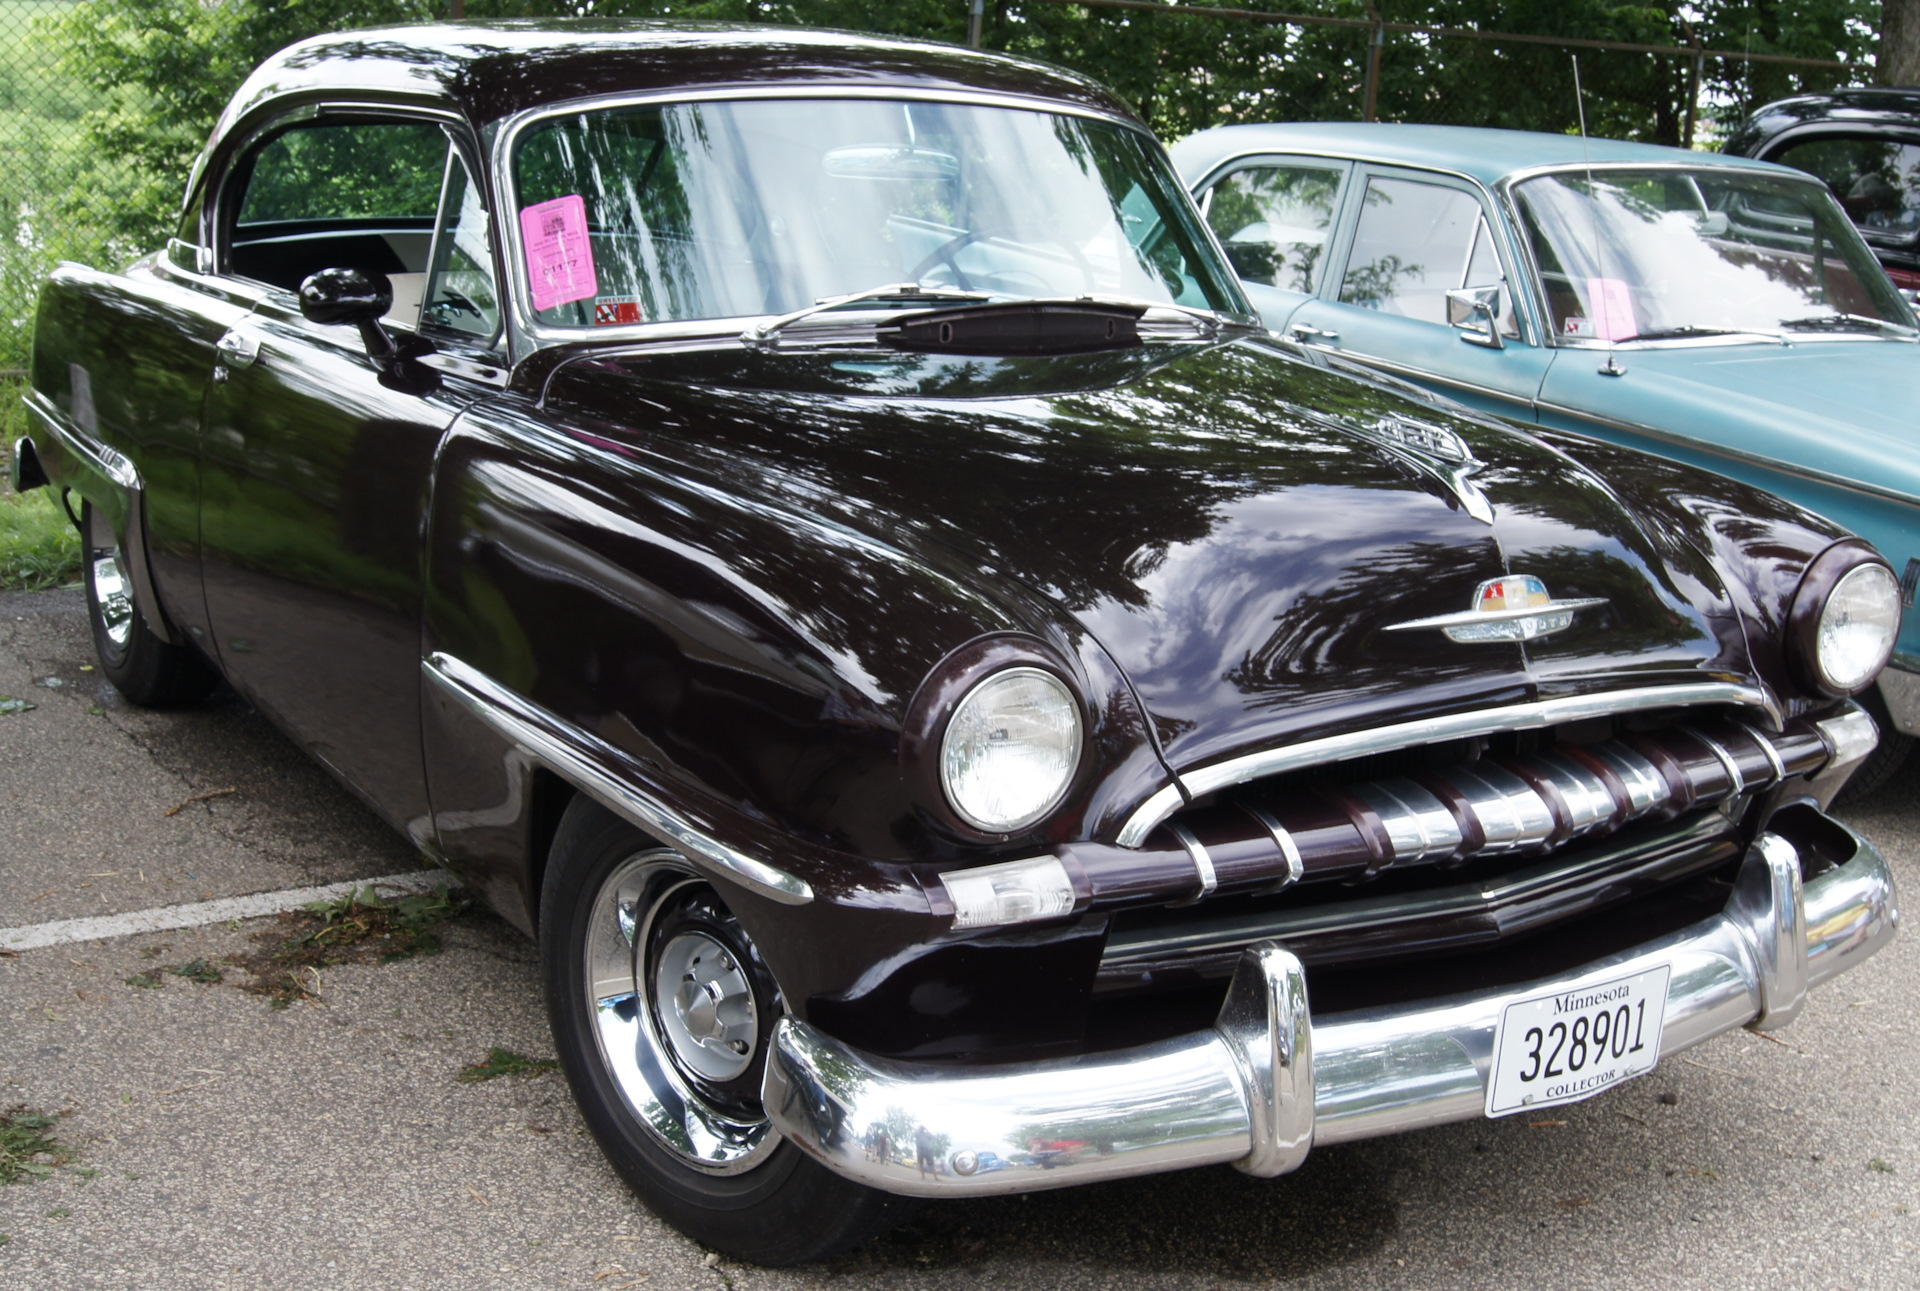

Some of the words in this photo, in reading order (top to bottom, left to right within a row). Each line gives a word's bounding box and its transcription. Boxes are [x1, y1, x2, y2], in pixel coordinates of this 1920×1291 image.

[1553, 984, 1630, 1016] Minnesota
[1520, 997, 1646, 1082] 328901
[1546, 1069, 1616, 1098] COLLECTOR
